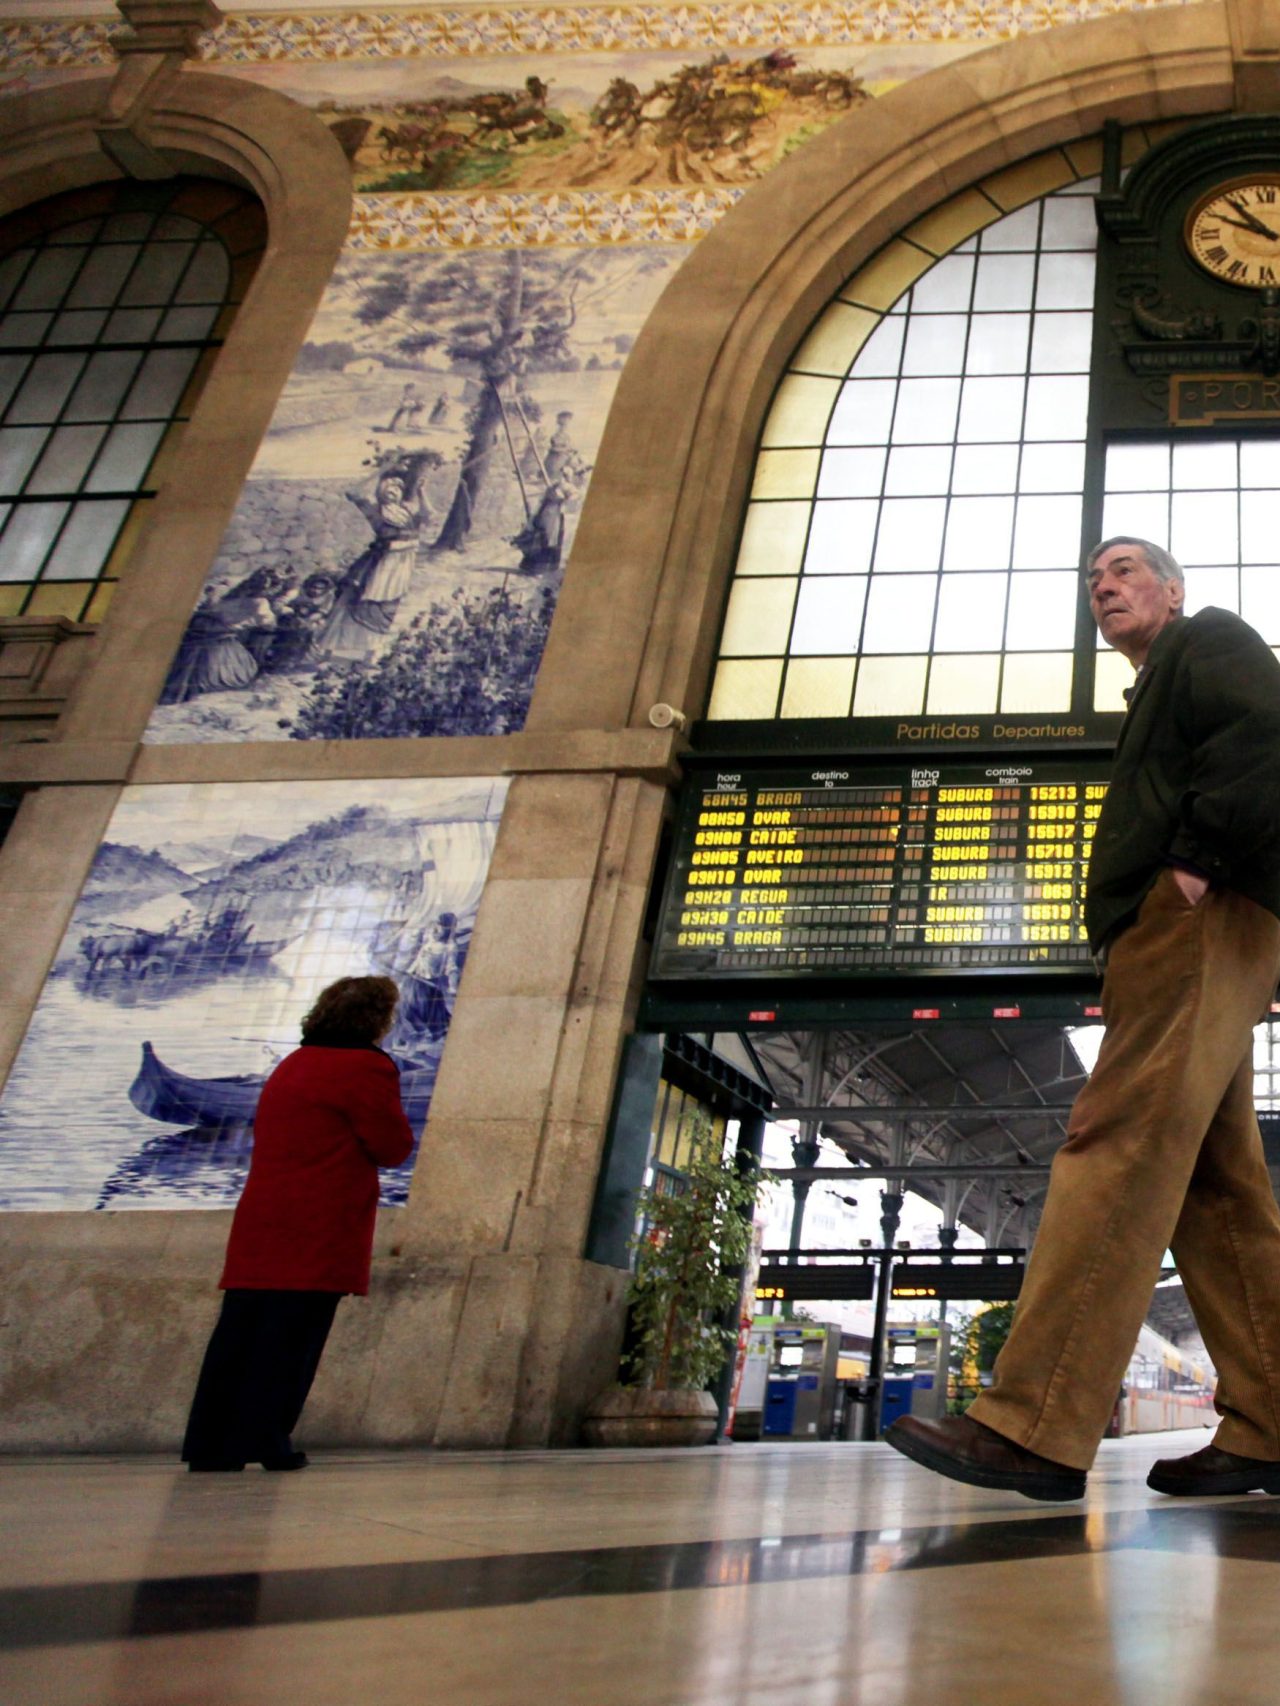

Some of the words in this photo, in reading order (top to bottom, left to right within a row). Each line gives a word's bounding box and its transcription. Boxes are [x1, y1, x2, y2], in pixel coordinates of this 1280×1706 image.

[897, 723, 980, 739] Partidas
[993, 724, 1085, 738] Departures
[717, 774, 741, 782] hora
[812, 771, 848, 780] destino
[911, 769, 940, 779] linha
[985, 767, 1032, 776] comboio
[824, 780, 834, 788] to
[912, 778, 938, 788] track
[756, 792, 802, 806] BRAGA
[938, 788, 993, 802] SUBURB
[1030, 786, 1076, 800] 15213
[698, 812, 746, 826] 08H50
[753, 810, 791, 825] OVAR
[936, 807, 992, 822] SUBURB
[750, 830, 797, 844] CAIDE
[934, 826, 990, 841] SUBURB
[692, 850, 739, 864] 09H05
[746, 850, 804, 864] AVEIRO
[932, 846, 989, 861] SUBURB
[688, 870, 736, 885] 09H10
[743, 870, 782, 884] OVAR
[930, 866, 987, 880] SUBURB
[1024, 864, 1074, 879] 15912
[684, 890, 732, 905] 09H20
[740, 890, 788, 904] REGUA
[928, 886, 948, 901] IR
[680, 911, 729, 926] 09H30
[736, 910, 785, 925] CAIDE
[926, 907, 984, 922] SUBURB
[677, 932, 725, 946] 09H45
[734, 931, 782, 945] BRAGA
[924, 928, 982, 943] SUBURB
[1022, 926, 1070, 940] 15215
